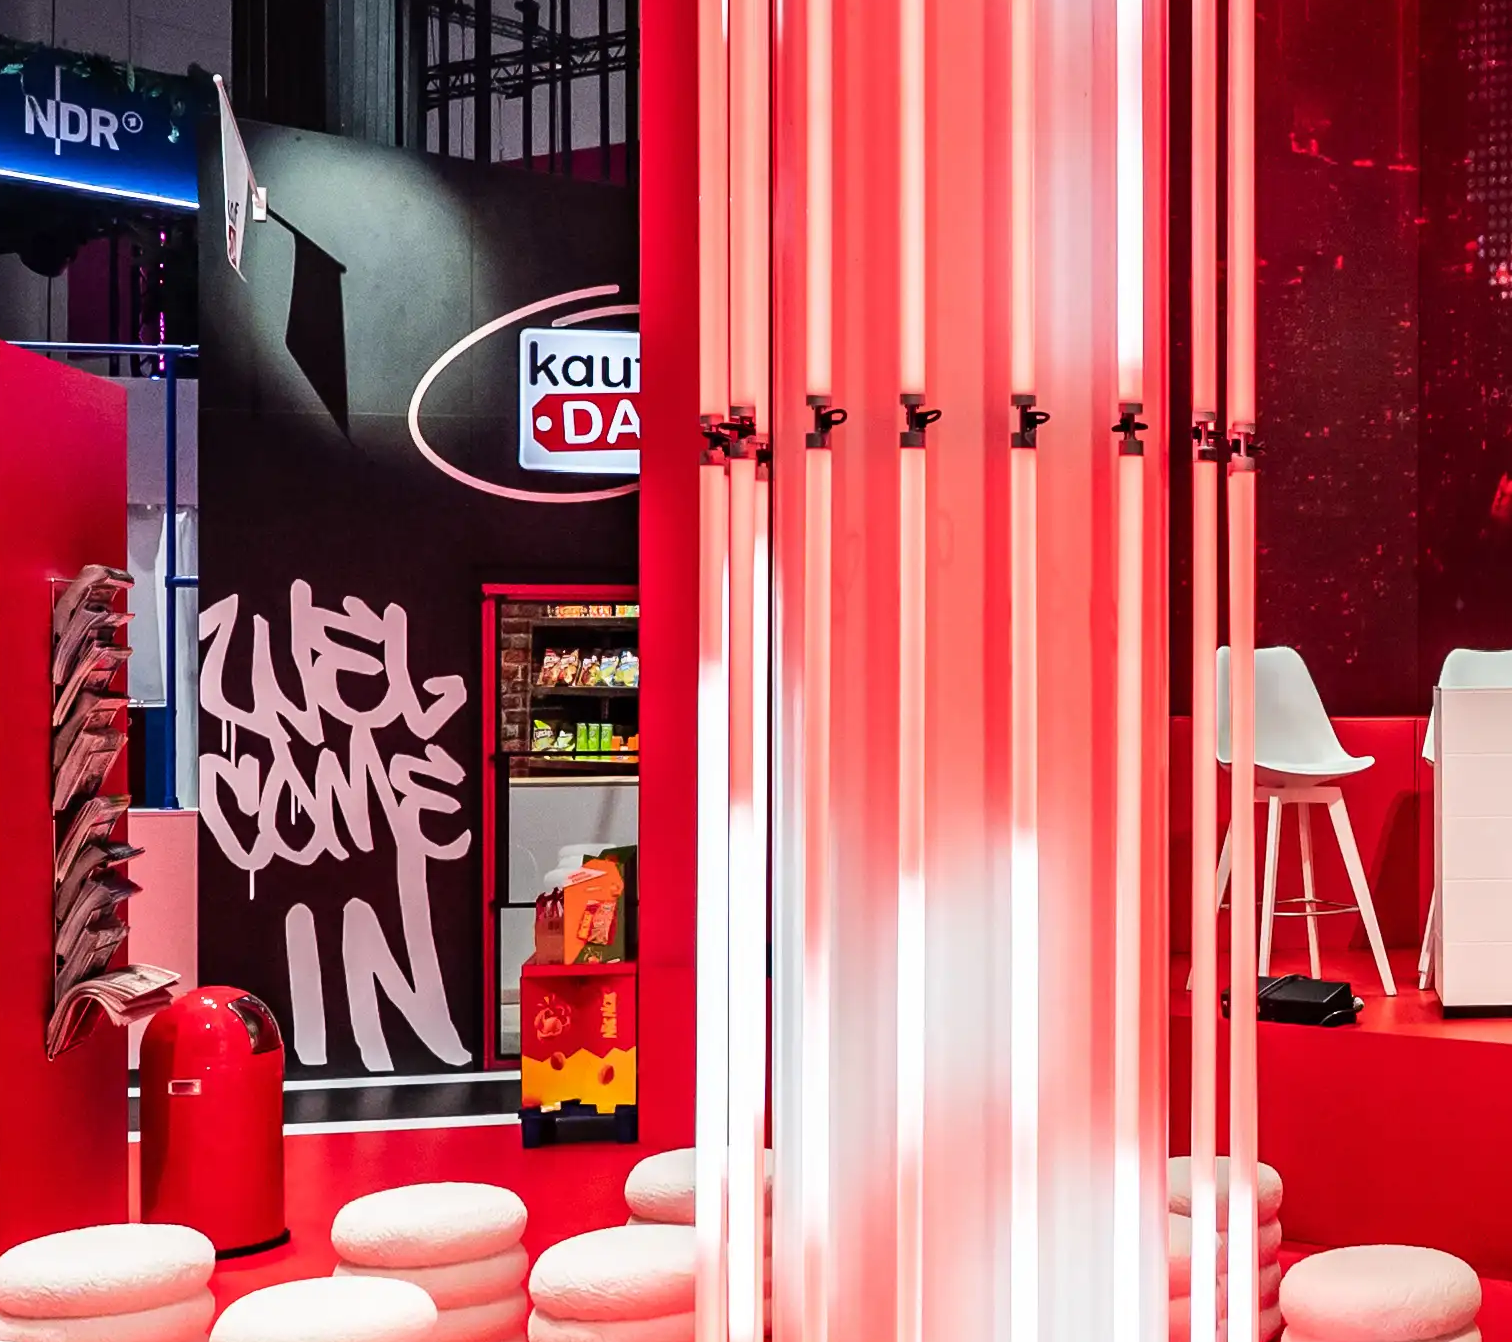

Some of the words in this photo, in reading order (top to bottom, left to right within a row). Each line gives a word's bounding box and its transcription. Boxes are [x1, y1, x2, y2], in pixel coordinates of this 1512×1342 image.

[25, 93, 120, 151] NDR
[529, 340, 640, 389] kau
[199, 578, 467, 746] WEL
[286, 879, 473, 1072] IN
